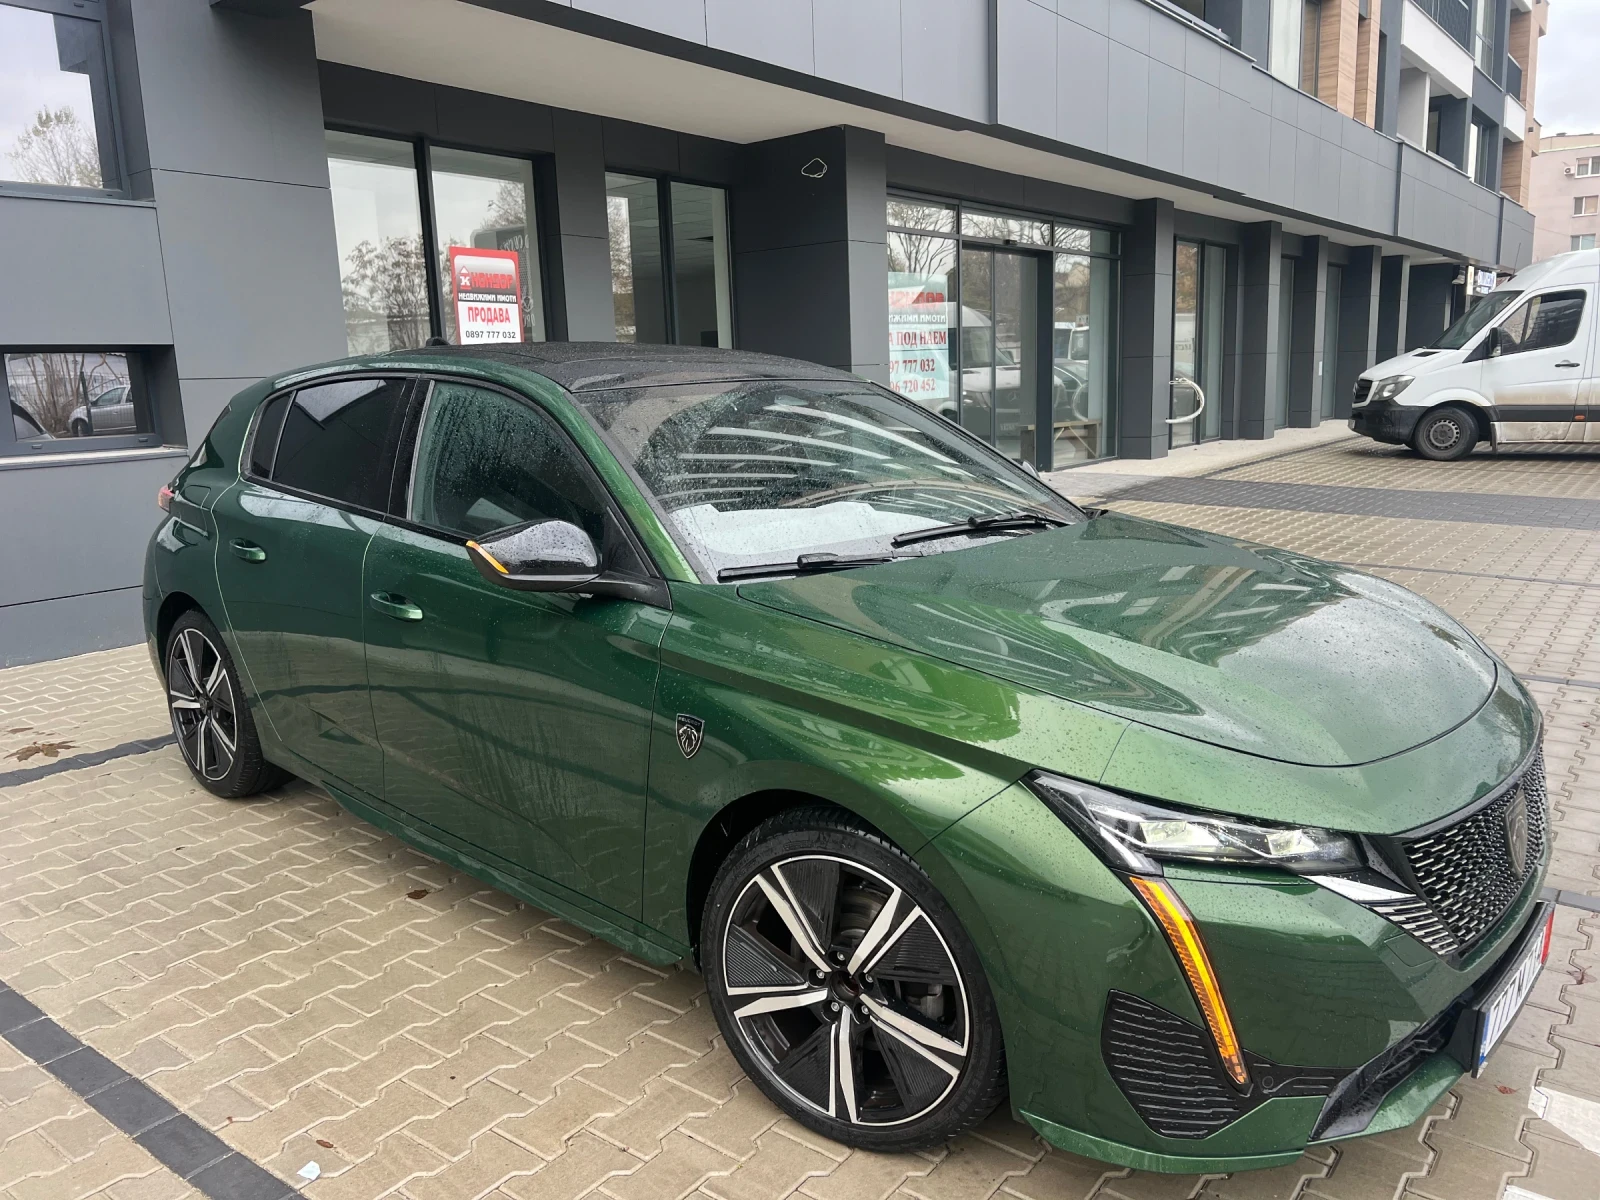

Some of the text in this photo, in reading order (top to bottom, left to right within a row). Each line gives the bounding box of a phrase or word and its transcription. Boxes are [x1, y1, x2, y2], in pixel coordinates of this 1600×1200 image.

[497, 294, 517, 303] ИМОТИ
[467, 307, 511, 325] ПРОДАВА
[920, 314, 946, 323] ИМОТИ
[465, 330, 516, 339] 0897 777 032
[896, 331, 918, 348] ПОД
[920, 331, 947, 345] НАЕМ
[902, 359, 918, 374] 777
[920, 359, 935, 372] 032
[903, 379, 919, 393] 720
[921, 378, 936, 391] 452
